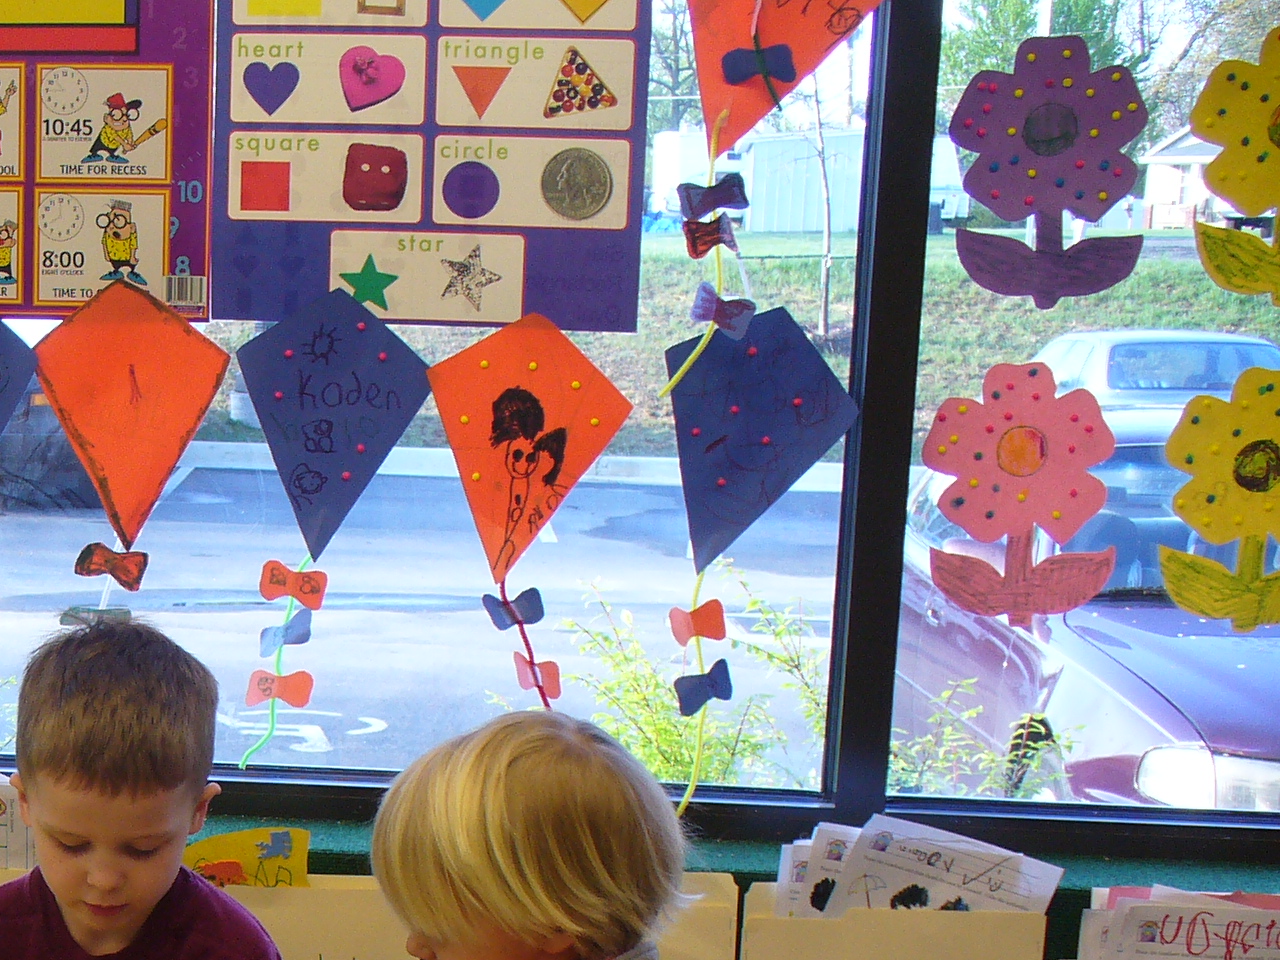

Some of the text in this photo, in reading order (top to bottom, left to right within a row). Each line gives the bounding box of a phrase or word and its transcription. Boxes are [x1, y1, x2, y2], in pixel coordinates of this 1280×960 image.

[237, 37, 305, 59] heart
[444, 40, 545, 66] triangle
[43, 118, 93, 136] 10:45
[235, 136, 320, 160] square
[440, 138, 509, 161] circle
[60, 165, 147, 175] TIME FOR RECESS
[177, 180, 204, 204] 10
[398, 235, 444, 253] star
[42, 251, 85, 268] 8:00
[175, 255, 190, 276] 8
[52, 288, 93, 298] TIME TO
